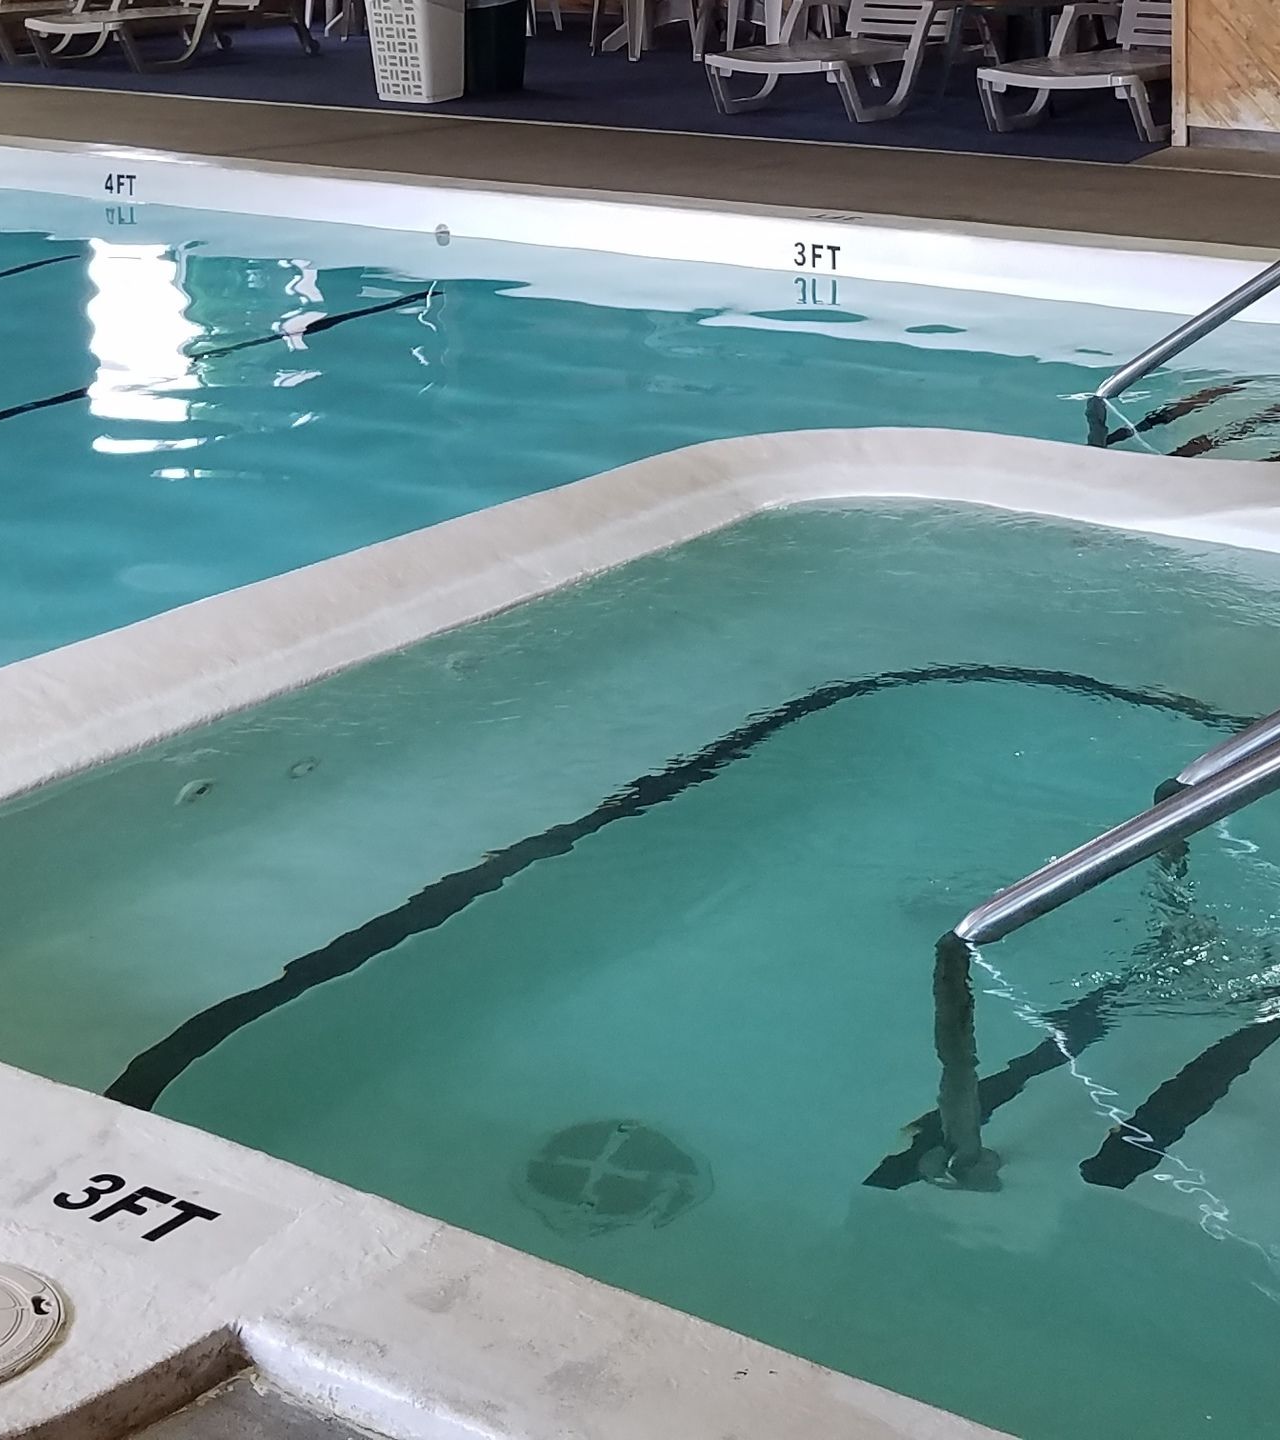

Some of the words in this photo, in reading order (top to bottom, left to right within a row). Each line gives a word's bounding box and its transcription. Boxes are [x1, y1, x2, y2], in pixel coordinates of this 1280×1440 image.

[105, 173, 137, 196] 4FT
[793, 242, 841, 270] 3FT
[53, 1173, 222, 1242] 3FT
